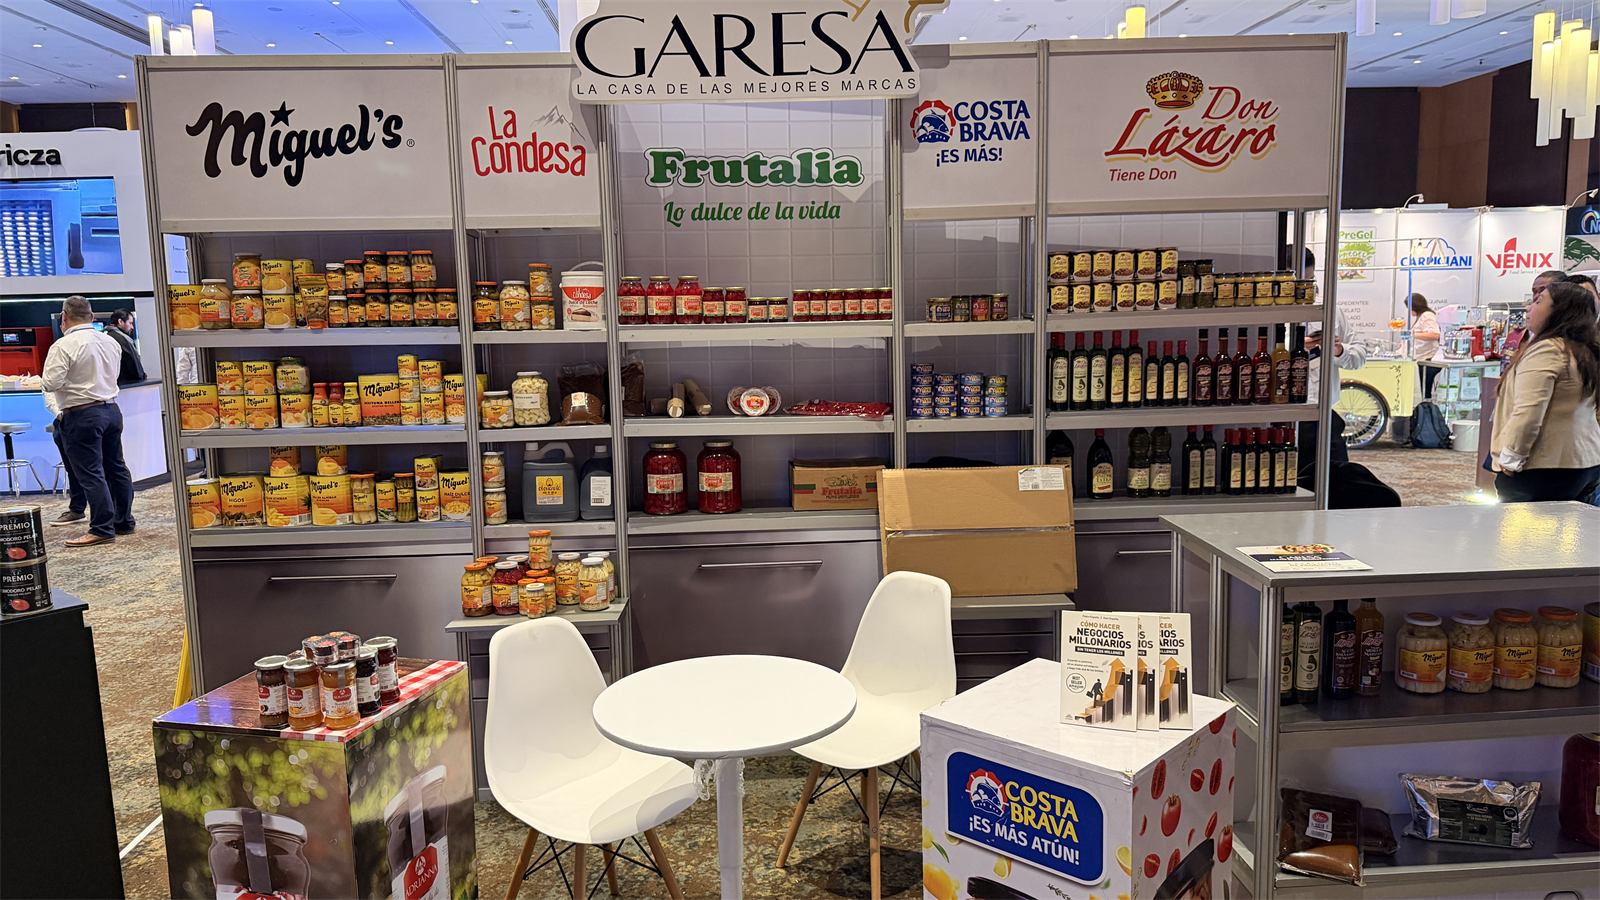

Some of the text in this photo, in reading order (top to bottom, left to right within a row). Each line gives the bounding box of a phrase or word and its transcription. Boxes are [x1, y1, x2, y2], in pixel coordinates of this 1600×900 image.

[575, 10, 914, 79] GARESA
[577, 78, 917, 95] LA CASA DE LAS MEJORES MARCAS
[953, 100, 1031, 122] COSTA
[1202, 85, 1279, 121] Don
[488, 105, 517, 141] La
[959, 121, 1031, 143] BRAVA
[186, 101, 403, 187] Miguel's
[1104, 108, 1277, 169] Lázaro
[471, 134, 587, 178] Condesa
[649, 149, 863, 186] Frutalia
[936, 144, 1003, 168] ¡ES MÁS!
[1109, 167, 1177, 182] Tiene Don
[664, 200, 841, 227] Lo dulce de la vida
[1486, 248, 1554, 275] VENIX
[441, 476, 470, 490] Miguel'
[2, 573, 34, 583] PREMIO
[1077, 627, 1124, 640] NEGOCIOS
[1080, 621, 1120, 630] CÓMO HACER
[1160, 622, 1173, 630] CER
[1069, 635, 1132, 649] MILLONARIOS
[1004, 781, 1079, 822] COSTA
[1010, 806, 1079, 843] BRAVA
[969, 815, 1080, 865] ¡ES MÁS ATÚN!
